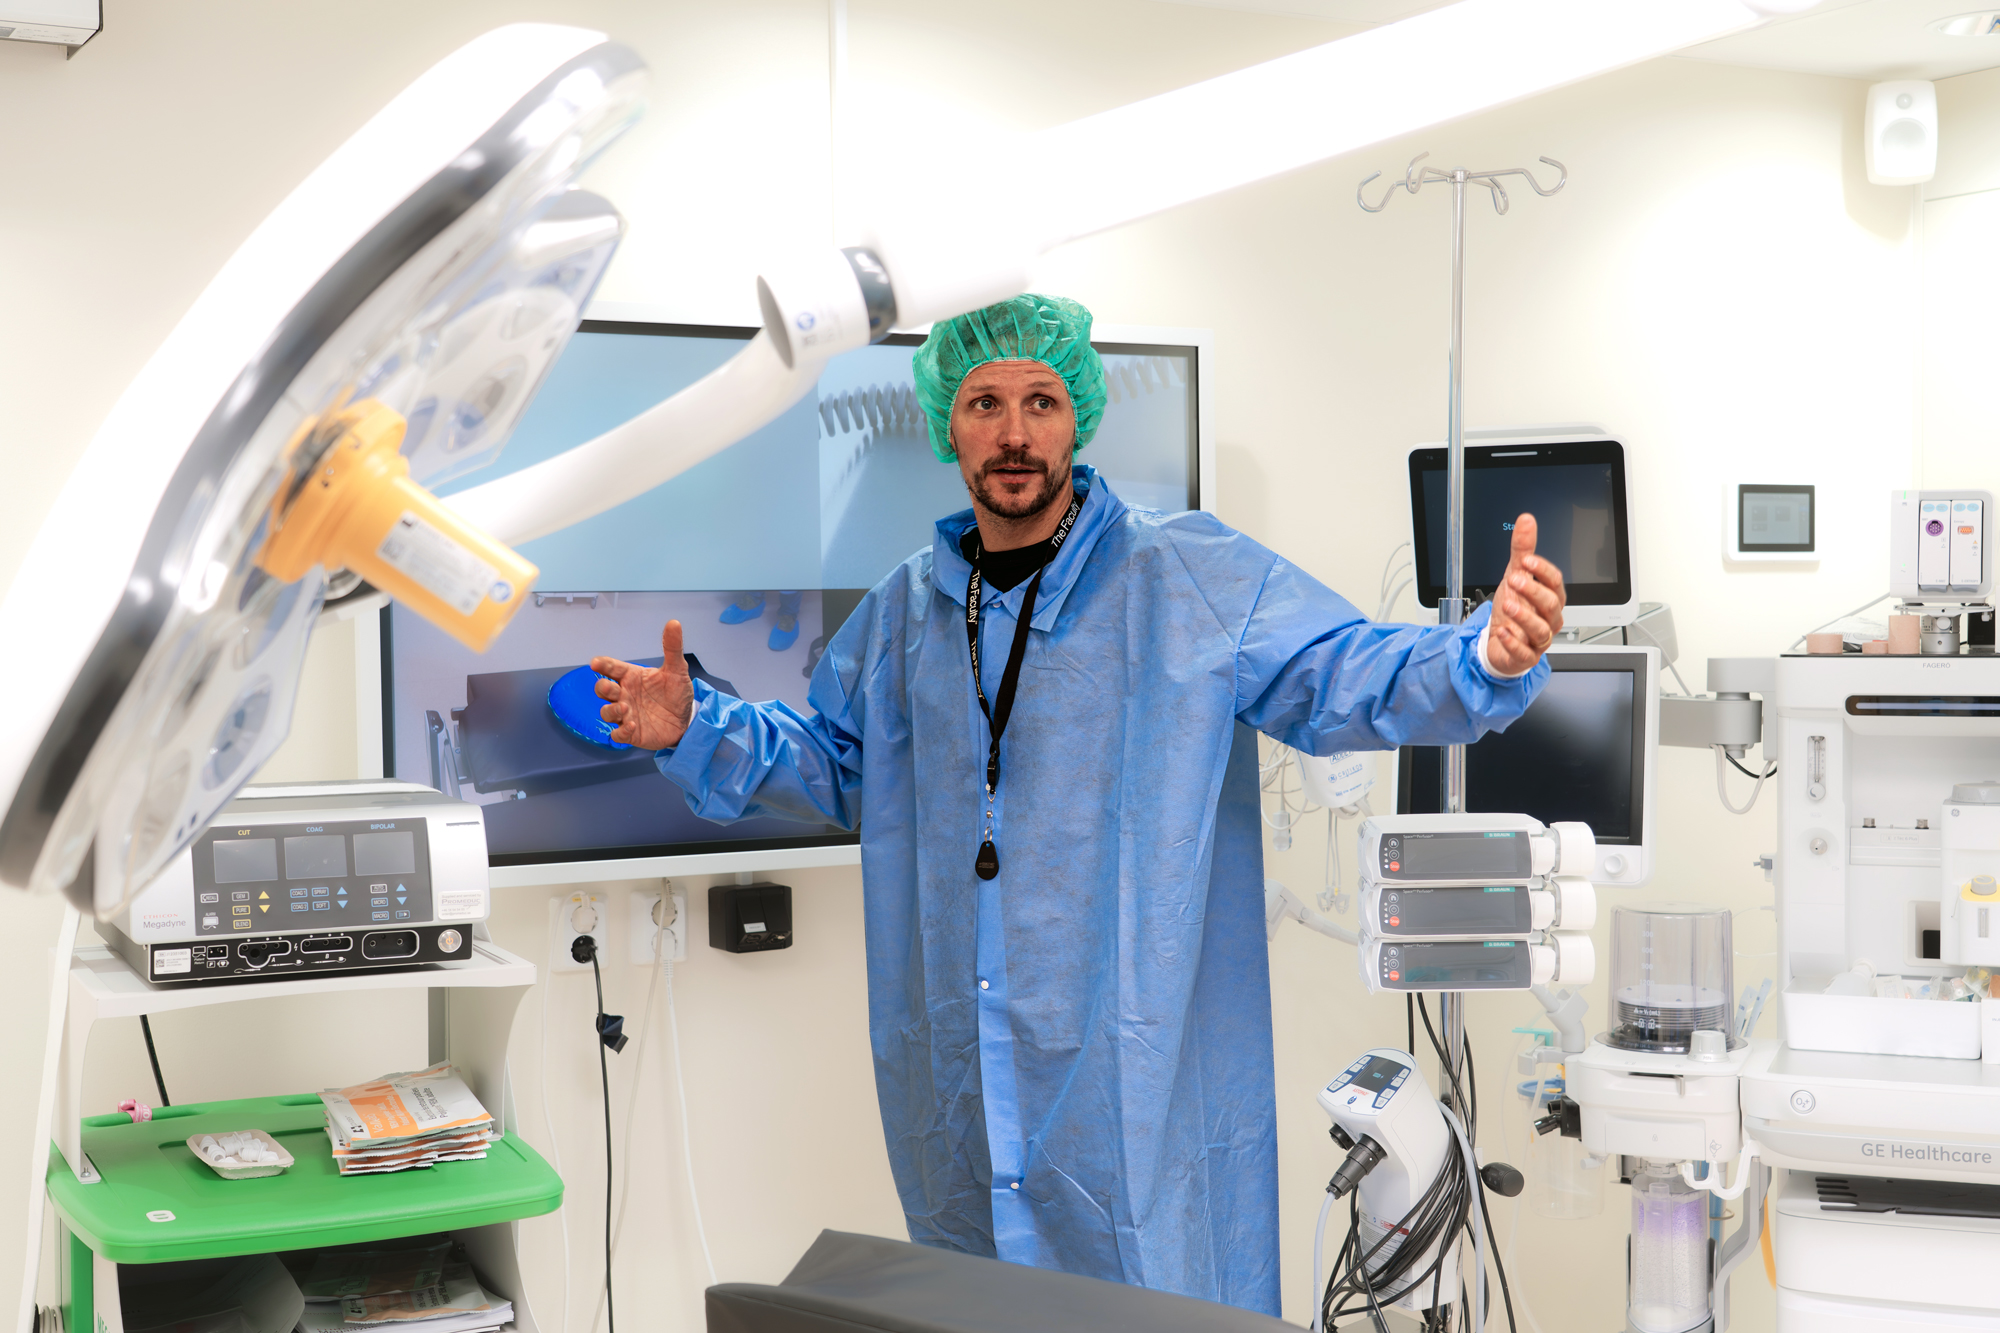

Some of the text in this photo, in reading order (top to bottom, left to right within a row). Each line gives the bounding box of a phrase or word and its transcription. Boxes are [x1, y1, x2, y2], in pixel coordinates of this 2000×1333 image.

[1051, 501, 1080, 547] The Faculty
[971, 570, 980, 589] The
[968, 589, 980, 623] Faculty
[143, 920, 187, 929] Megadyne
[1861, 1142, 1992, 1164] GE Healthcare
